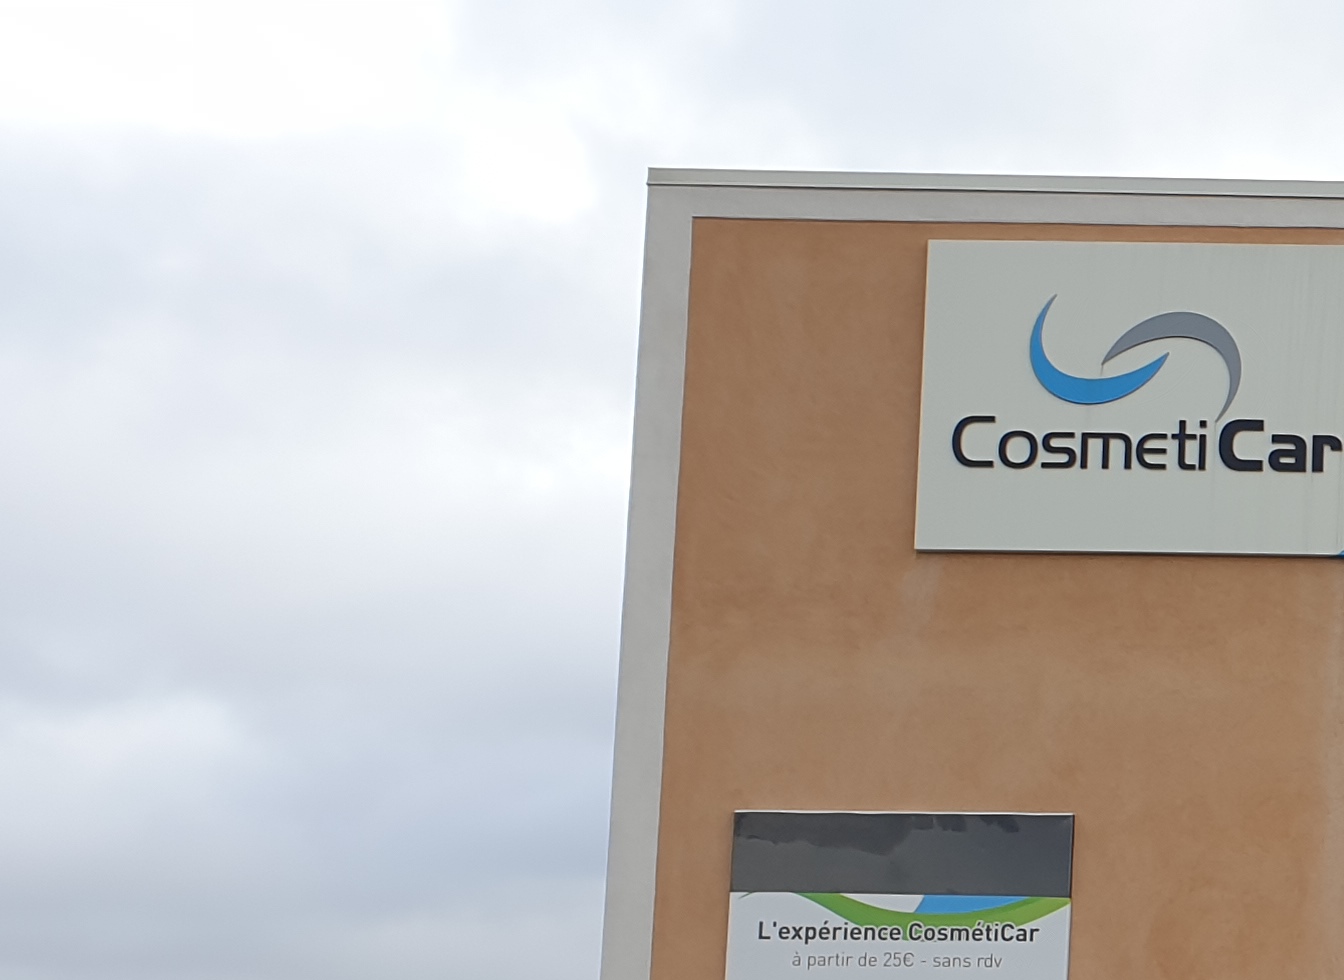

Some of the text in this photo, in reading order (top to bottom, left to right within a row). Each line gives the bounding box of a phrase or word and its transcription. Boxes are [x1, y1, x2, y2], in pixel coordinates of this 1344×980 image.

[758, 920, 1040, 945] L'expérience CosmétiCar
[792, 952, 801, 967] à
[807, 953, 854, 970] partir
[858, 954, 877, 967] de
[883, 953, 914, 968] 25€
[933, 957, 972, 968] sans
[977, 953, 1003, 969] rdv
